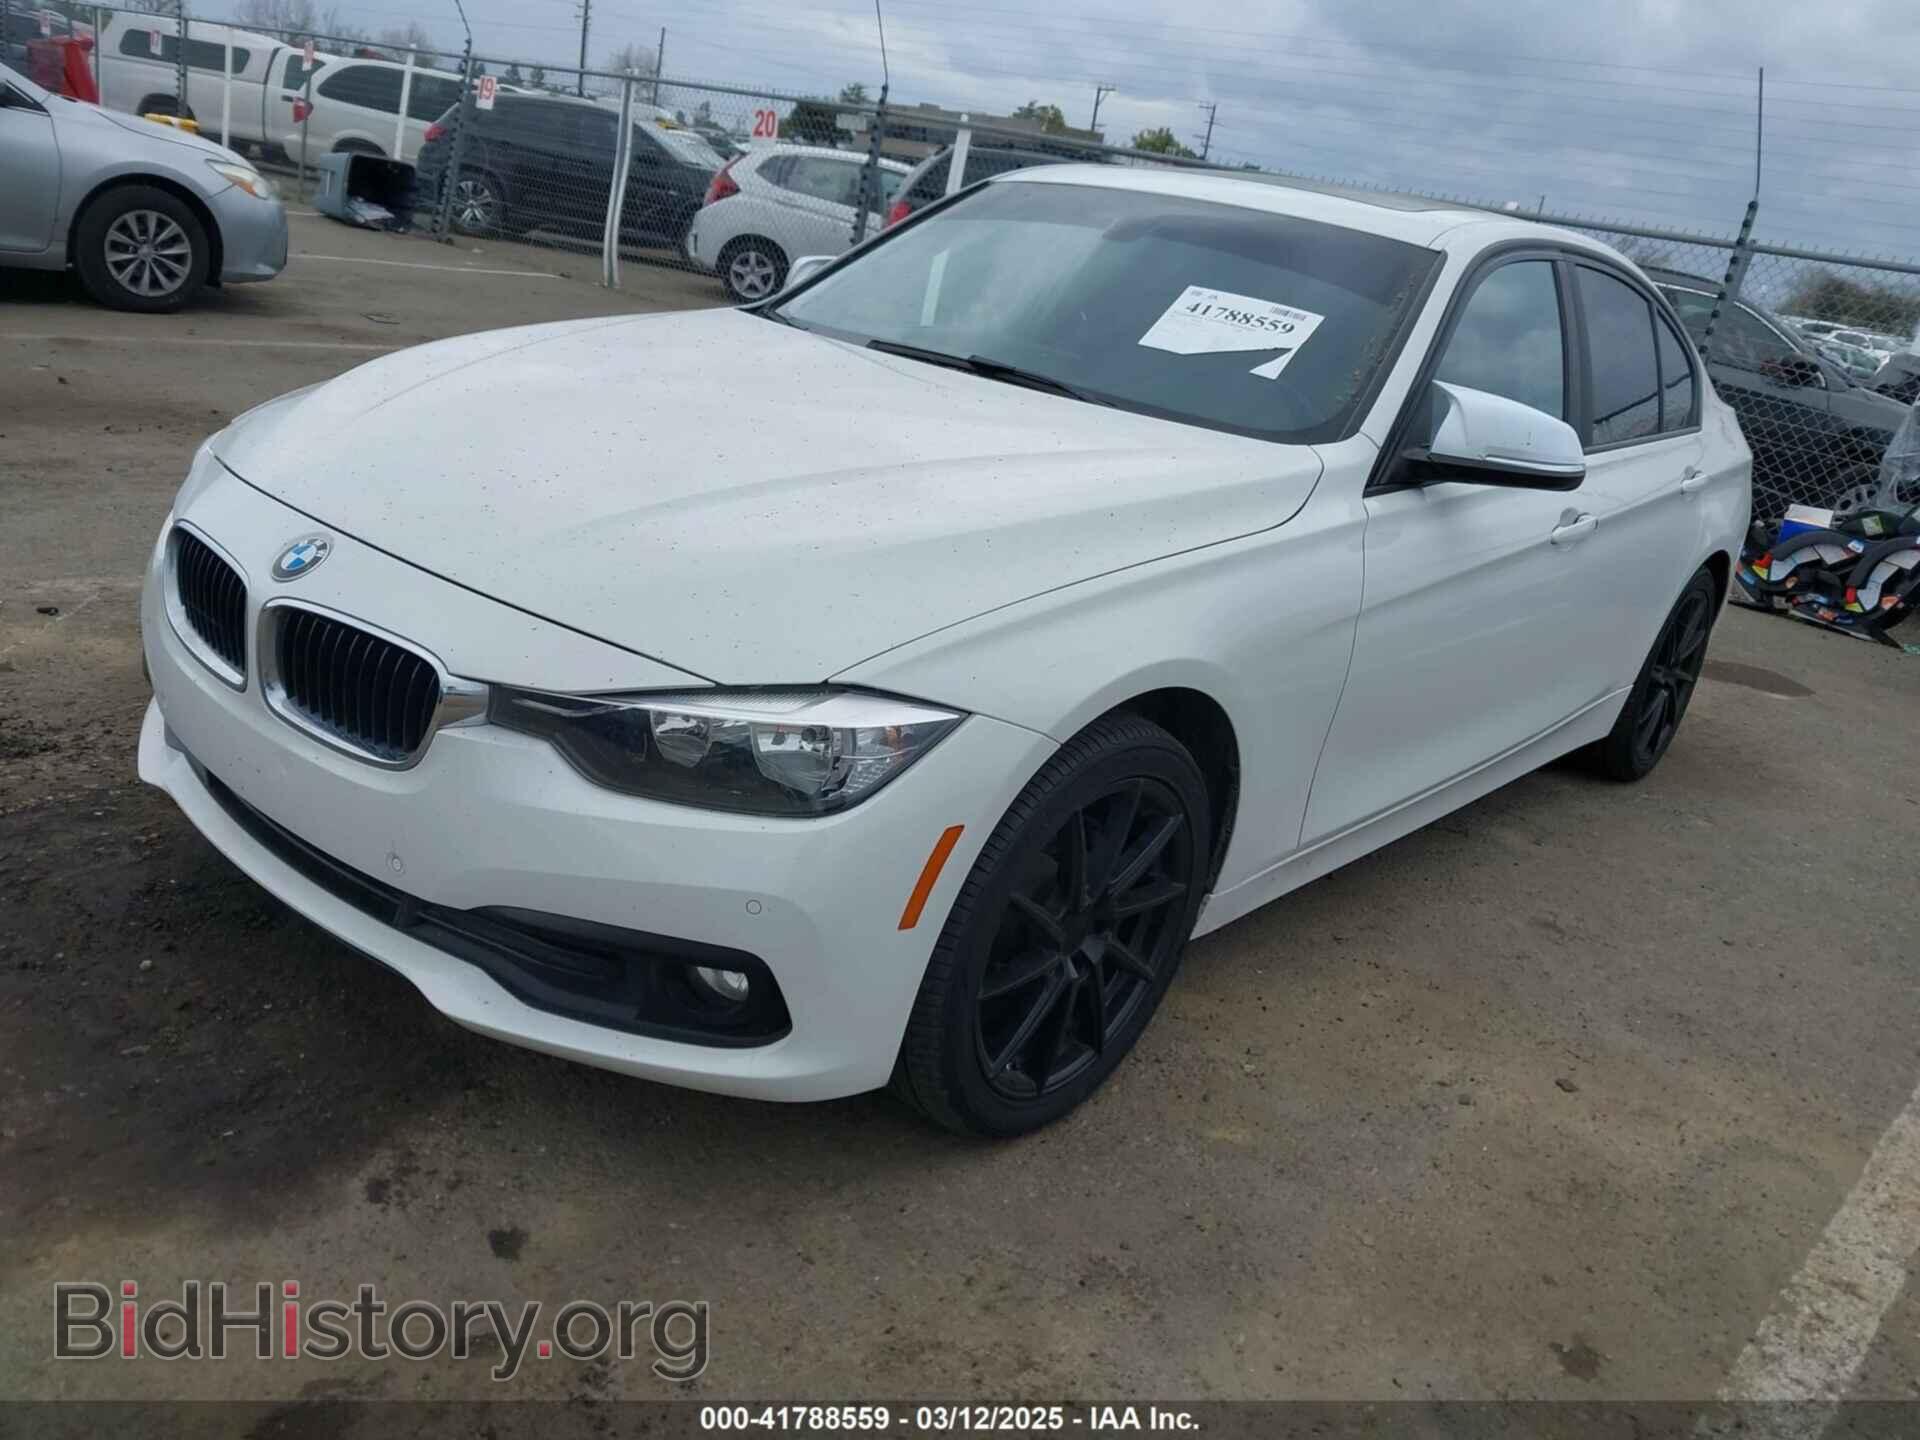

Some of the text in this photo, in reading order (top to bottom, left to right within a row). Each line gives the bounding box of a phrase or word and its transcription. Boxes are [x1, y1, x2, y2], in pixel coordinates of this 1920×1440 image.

[479, 78, 494, 99] 19
[753, 109, 775, 138] 20
[1186, 302, 1296, 334] 41788559
